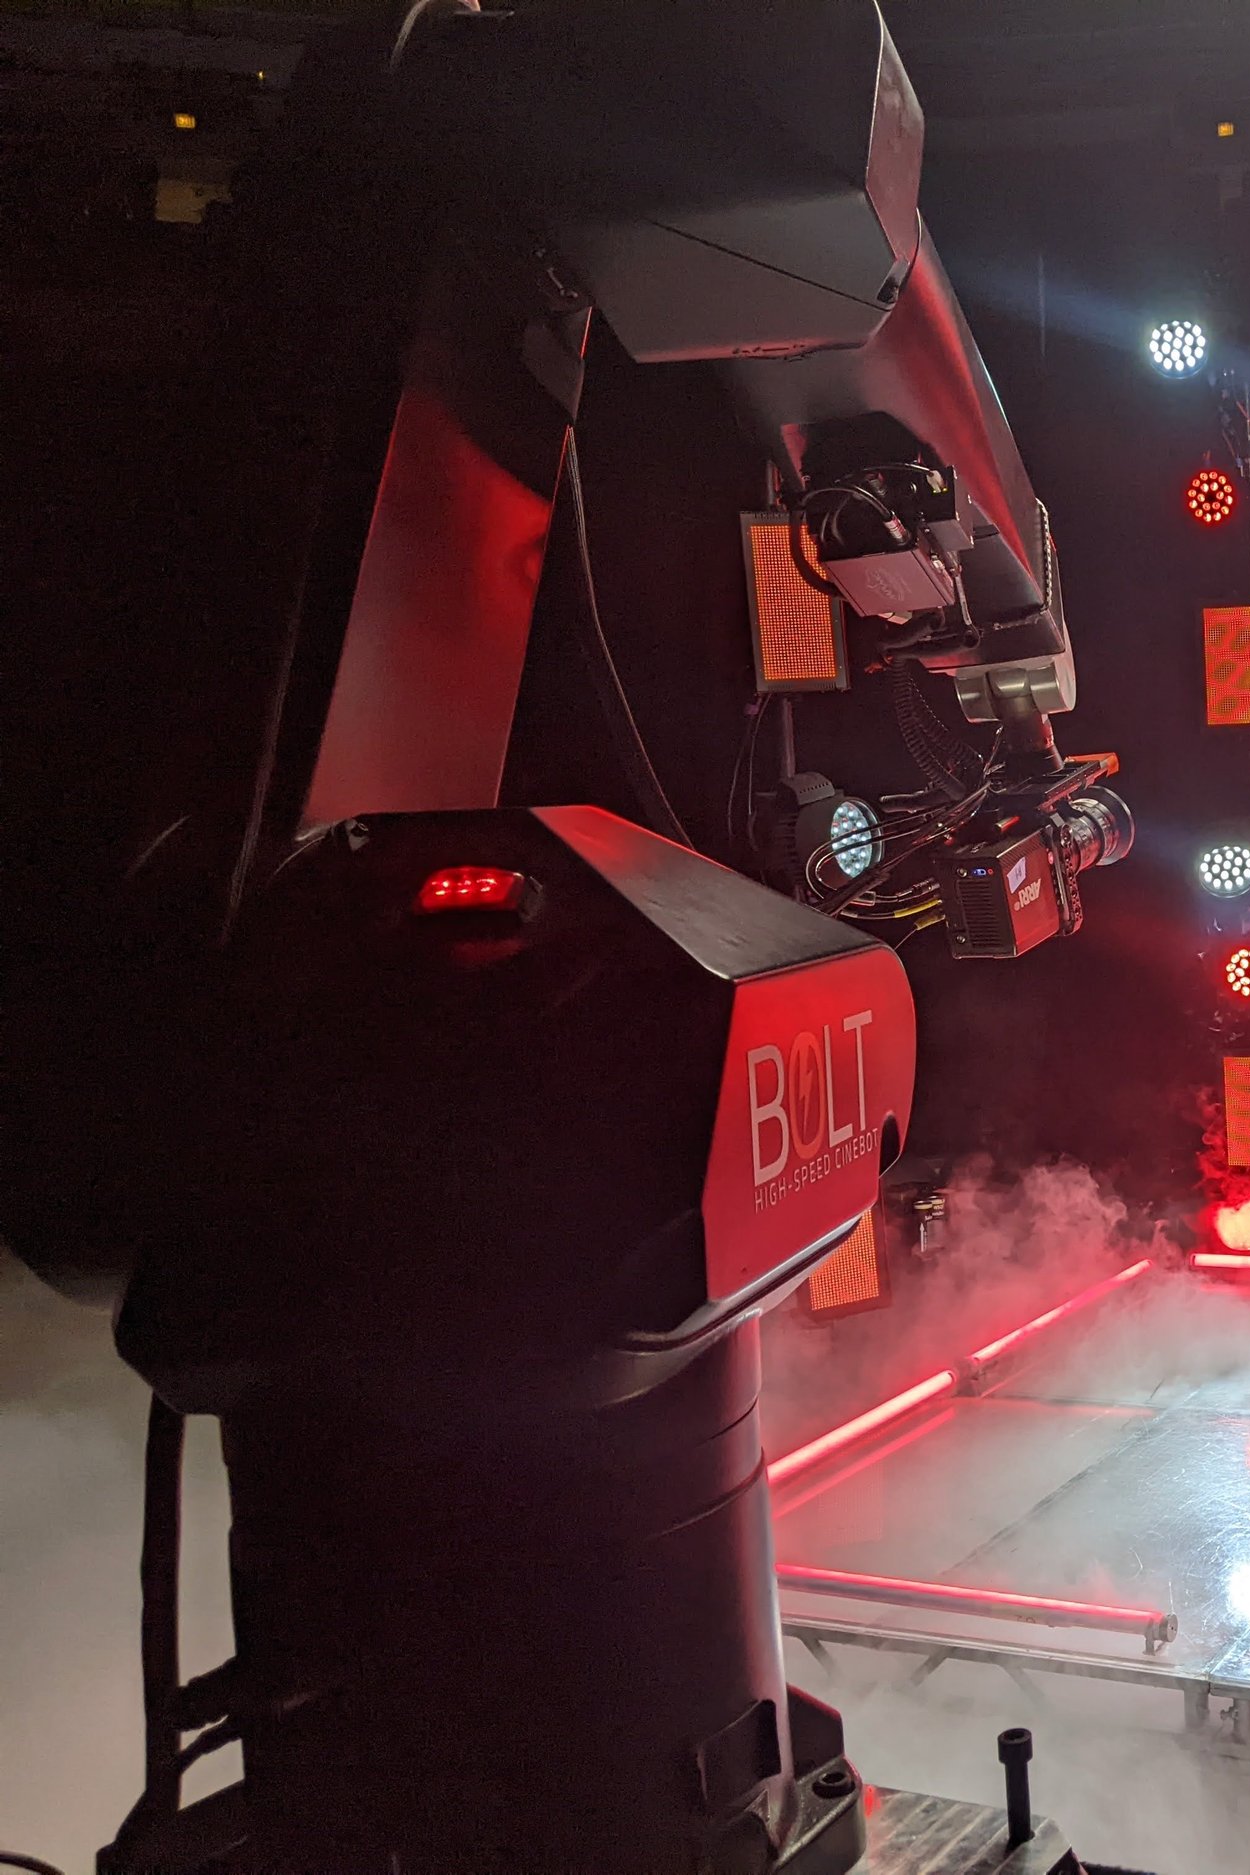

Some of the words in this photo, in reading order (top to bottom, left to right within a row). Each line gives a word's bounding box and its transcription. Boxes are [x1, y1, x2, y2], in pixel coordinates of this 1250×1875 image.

[1018, 878, 1042, 908] ARRI
[747, 1010, 873, 1187] BOLT
[755, 1154, 831, 1214] HIGH-SPEED
[835, 1128, 878, 1169] CINEBOT
